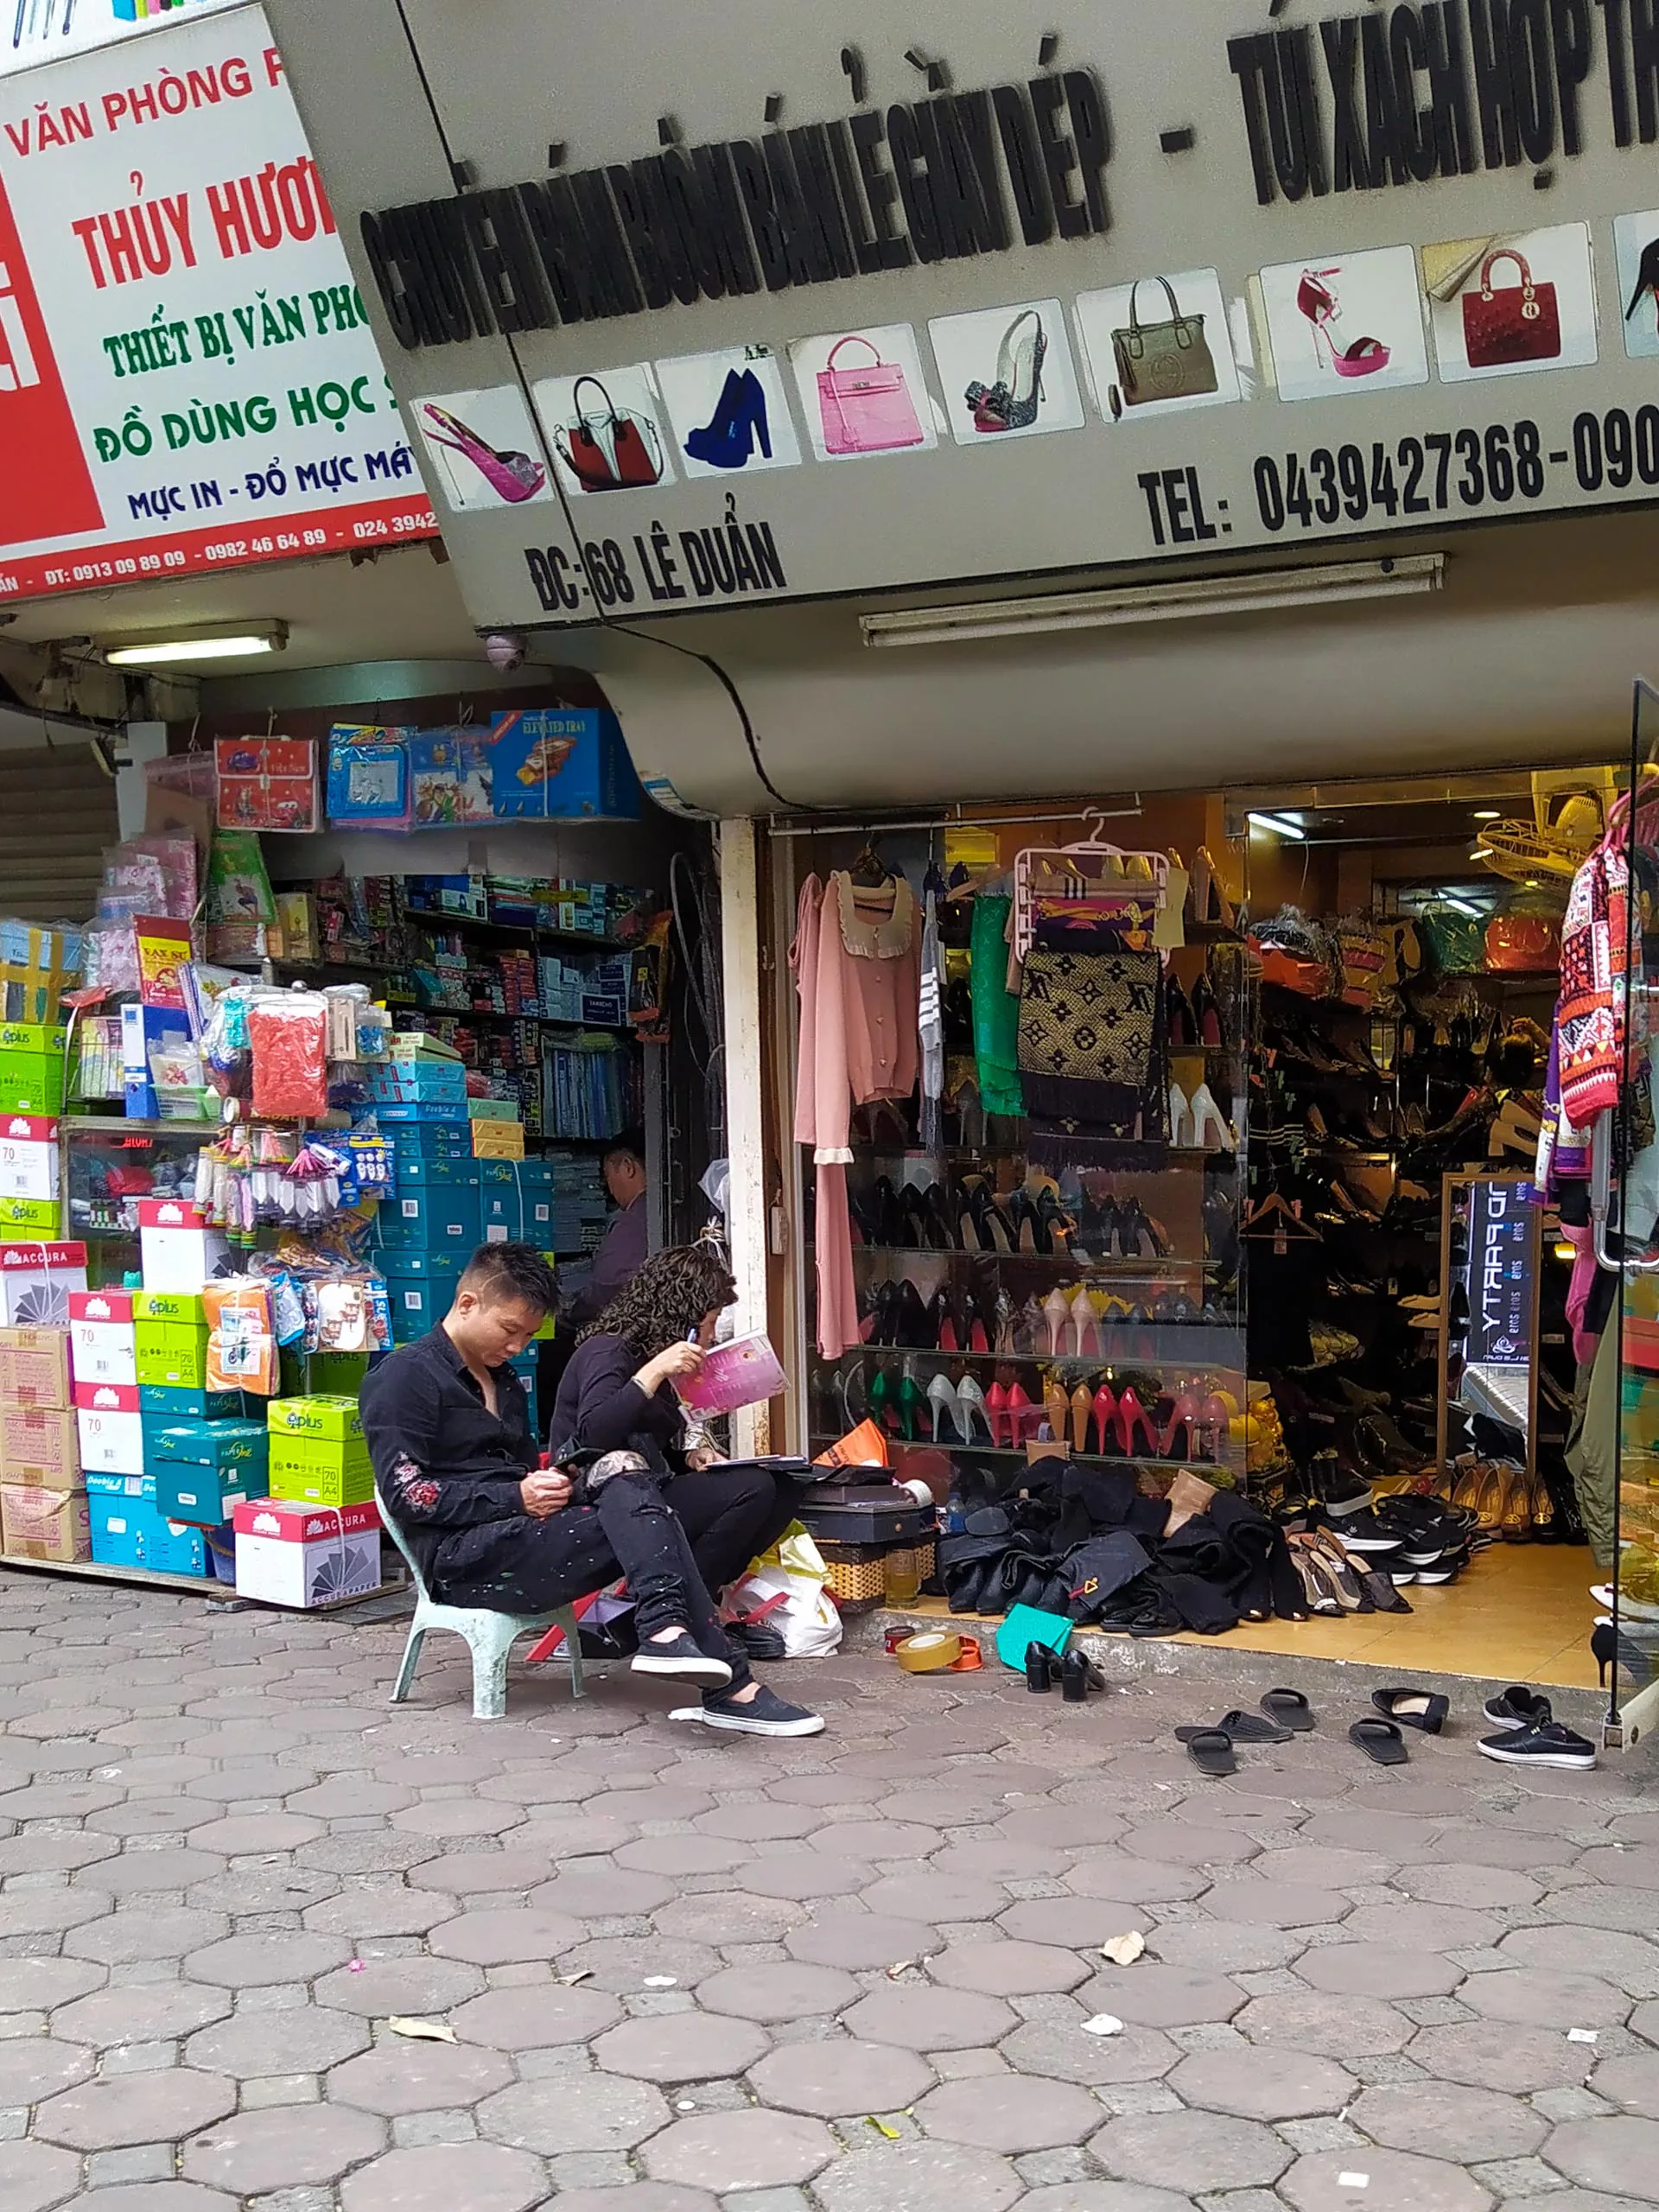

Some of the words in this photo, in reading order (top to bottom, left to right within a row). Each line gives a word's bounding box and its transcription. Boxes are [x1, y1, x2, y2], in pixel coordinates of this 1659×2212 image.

[3, 101, 94, 157] VĂN
[101, 57, 253, 131] PHÒNG
[990, 35, 1109, 247] DÉP
[71, 169, 198, 289] THỦY
[103, 303, 192, 378] THIẾT
[194, 312, 235, 365] BỊ
[232, 289, 306, 349] VĂN
[92, 405, 153, 463] ĐỒ
[162, 398, 277, 450] DÙNG
[286, 375, 376, 433] HỌC
[127, 485, 187, 520] MỰC
[190, 480, 223, 509] IN
[245, 456, 288, 499] ĐỔ
[295, 456, 359, 493] MỰC
[1137, 466, 1233, 546] TEL:
[44, 570, 72, 586] ĐT:
[72, 562, 113, 582] 0913
[115, 558, 137, 575] 09
[139, 554, 162, 571] 89
[163, 550, 186, 567] 09
[204, 540, 248, 562] 0982
[251, 536, 274, 554] 46
[276, 532, 301, 551] 64
[302, 529, 327, 546] 89
[353, 518, 388, 539] 024
[391, 511, 439, 534] 3942
[632, 519, 687, 601] LÊ
[677, 491, 788, 597] DUẨN
[22, 1251, 67, 1264] ACCURA
[324, 1471, 336, 1481] 70
[324, 1486, 337, 1495] A4
[324, 1514, 366, 1532] ACCURA
